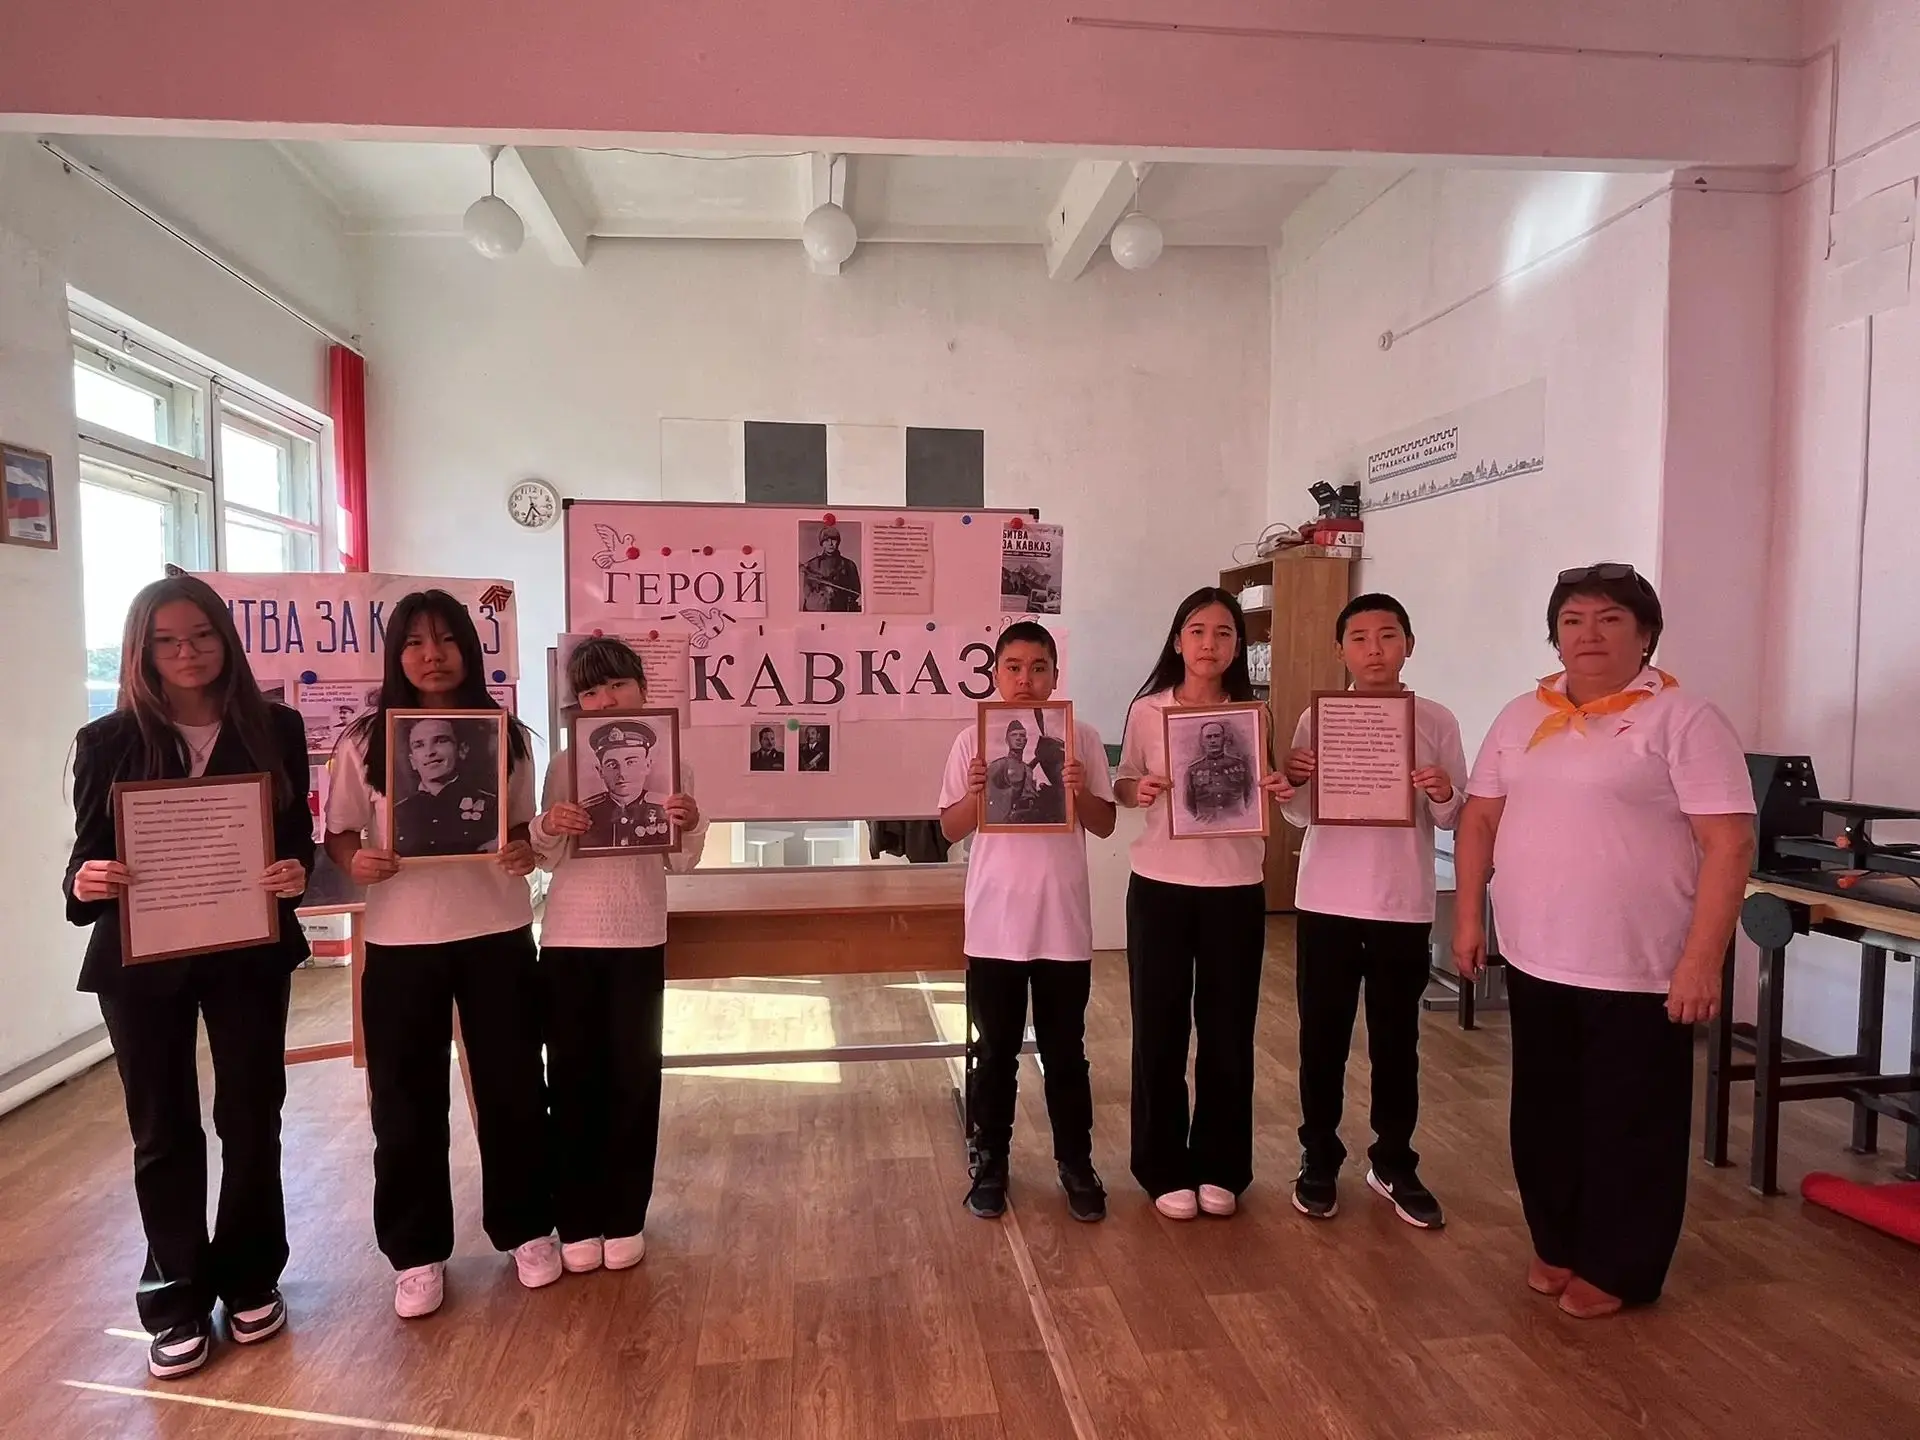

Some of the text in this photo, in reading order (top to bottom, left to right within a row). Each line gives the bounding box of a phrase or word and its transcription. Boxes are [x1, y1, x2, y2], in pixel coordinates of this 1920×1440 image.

[1371, 441, 1455, 473] АСТРАХАНСКАЯ ОБЛАСТЬ
[1002, 530, 1028, 540] БИТВА
[1002, 540, 1051, 552] ЗА КАВКАЗ
[604, 561, 765, 605] ГЕРОЙ
[228, 600, 304, 653] ТВА
[315, 601, 359, 654] ЗА
